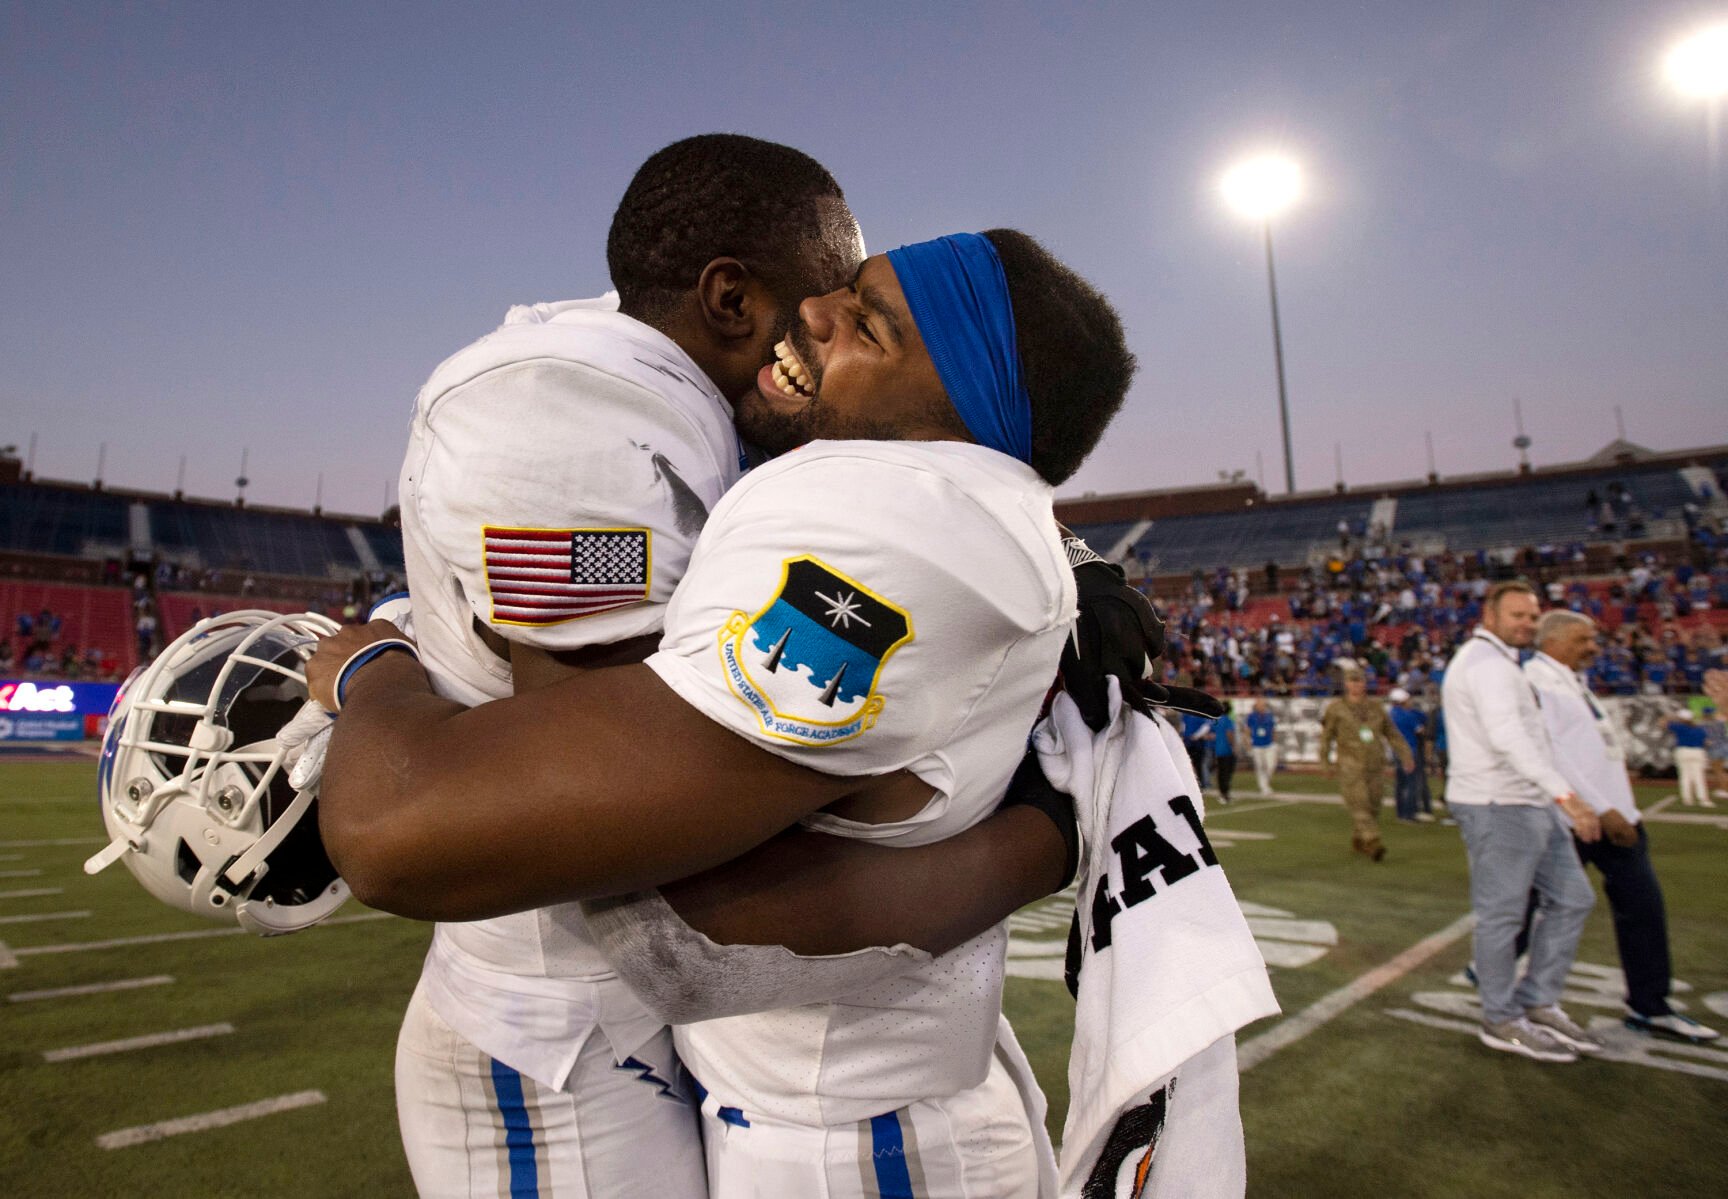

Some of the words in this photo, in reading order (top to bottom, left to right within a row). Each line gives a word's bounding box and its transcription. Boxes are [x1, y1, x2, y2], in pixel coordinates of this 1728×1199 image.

[725, 643, 743, 683] UNITED
[738, 680, 766, 710] STATES
[775, 722, 809, 737] FORCE
[809, 719, 862, 740] ACADEMY
